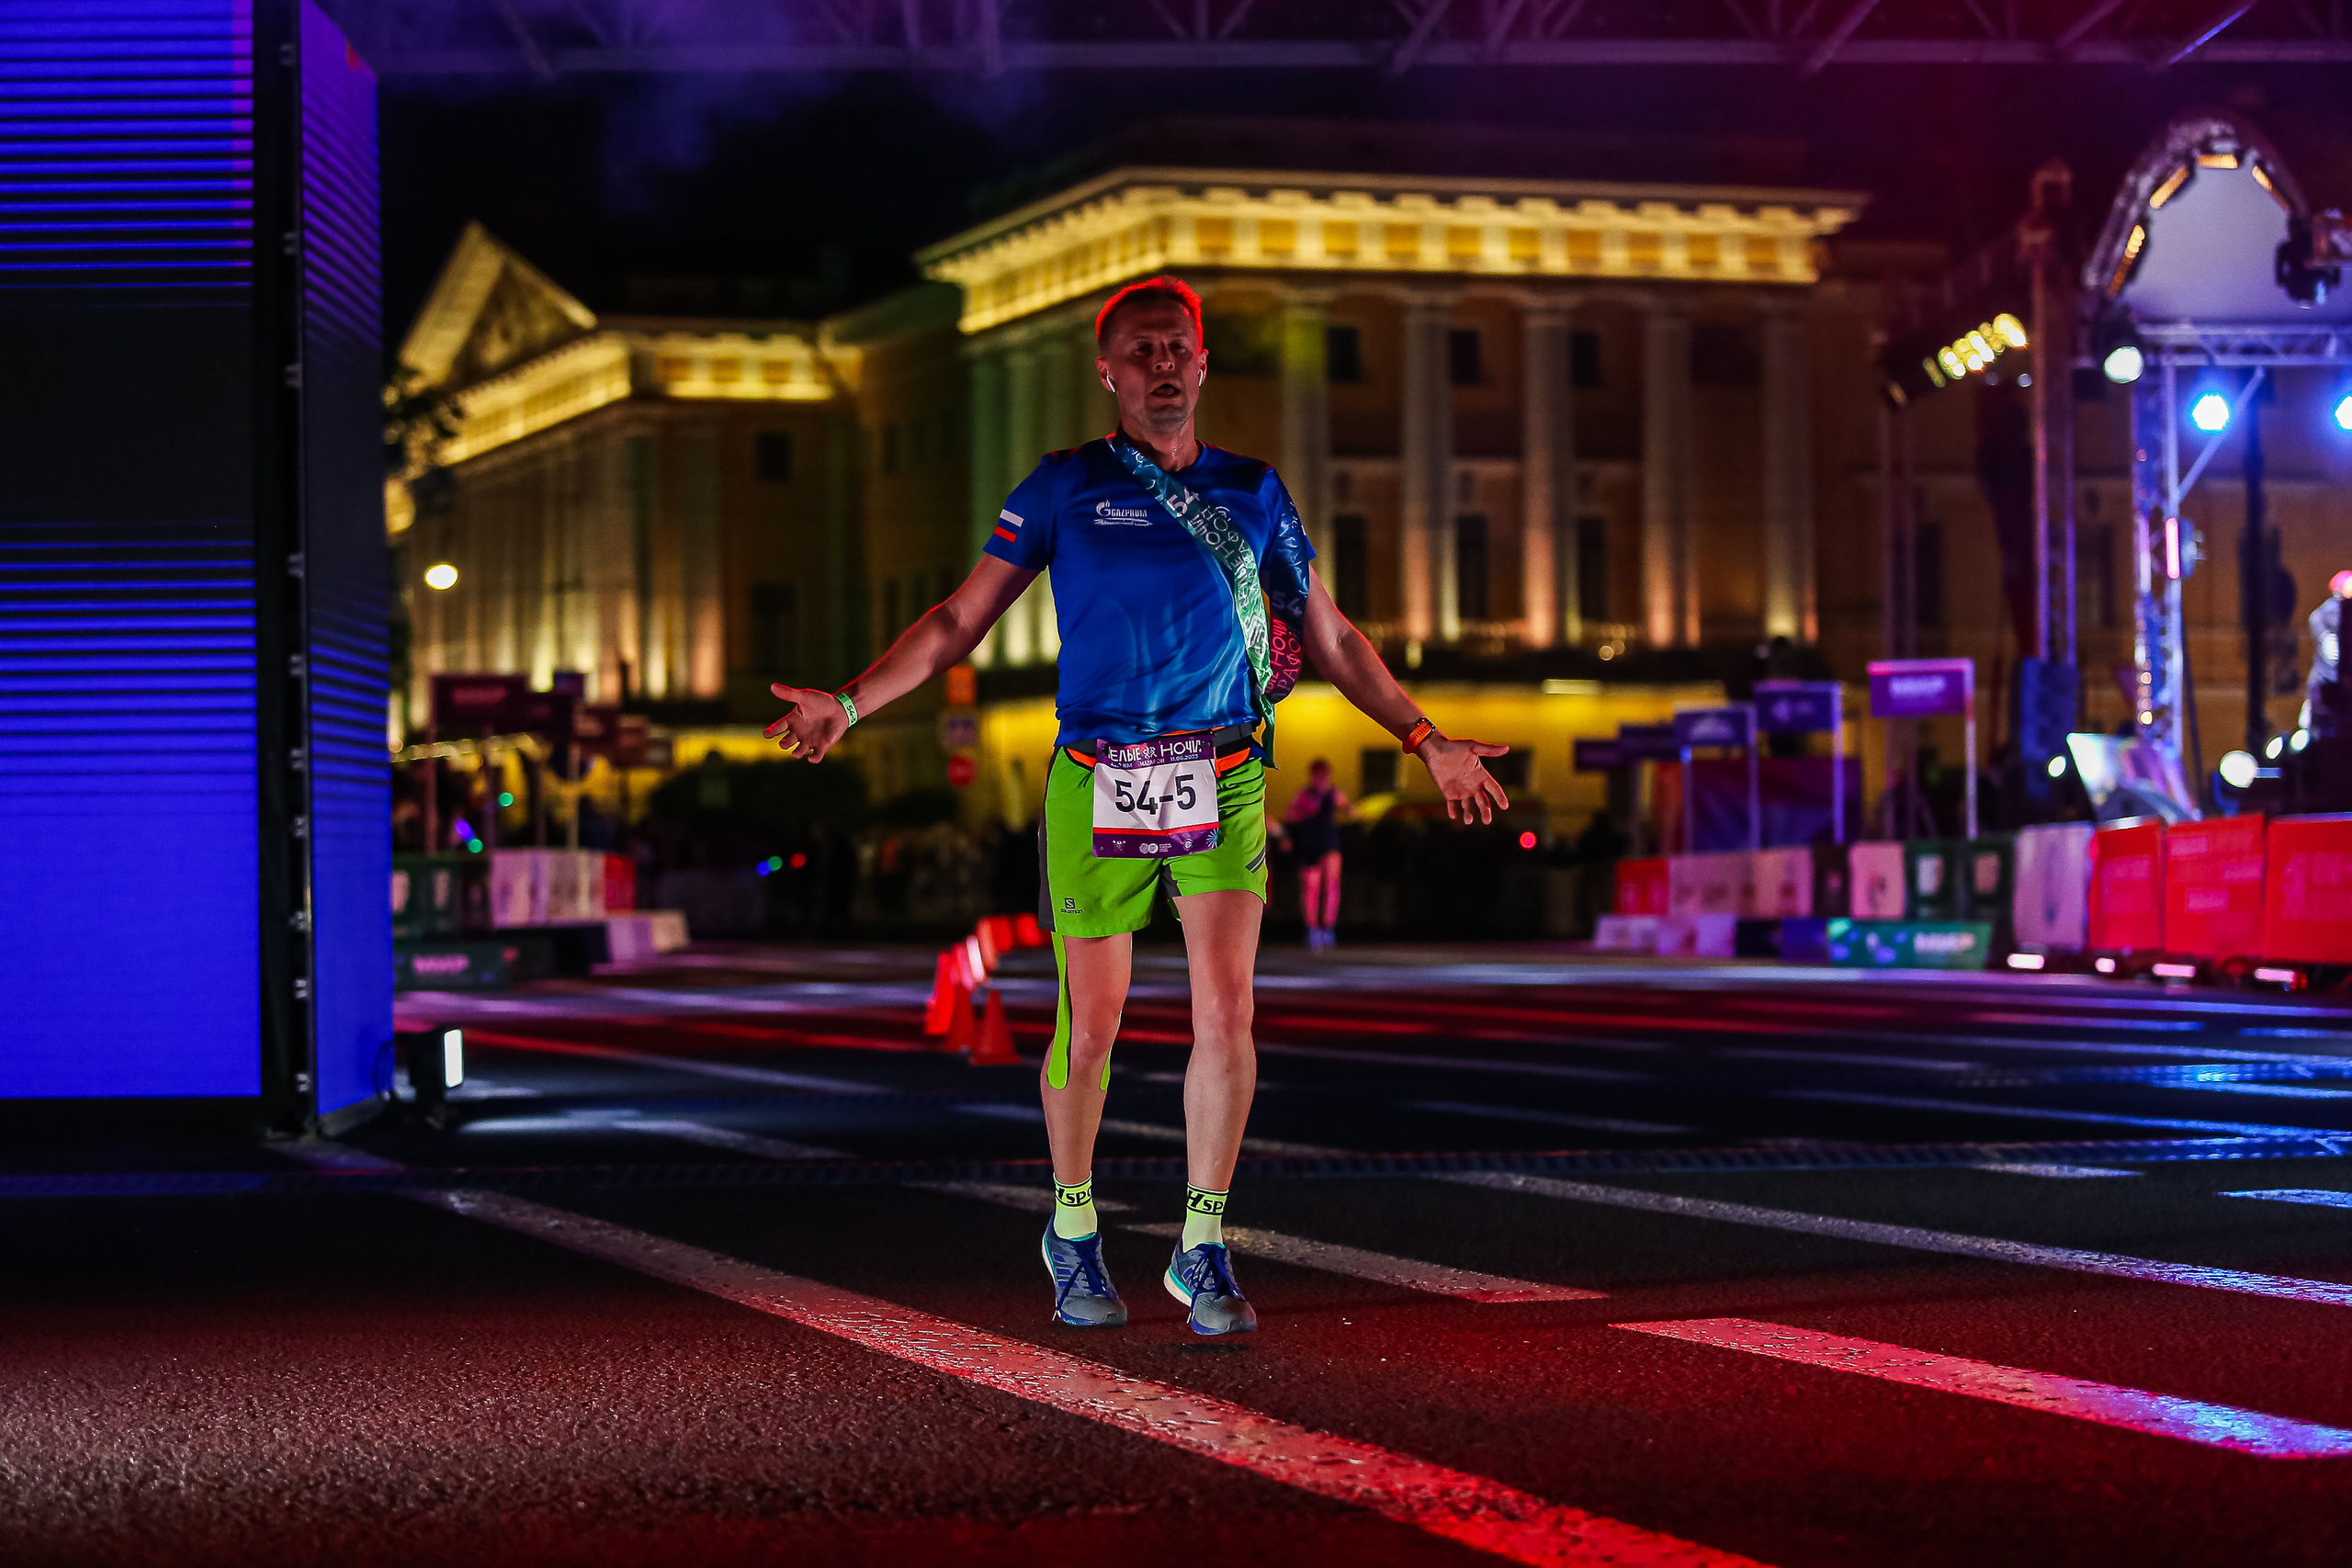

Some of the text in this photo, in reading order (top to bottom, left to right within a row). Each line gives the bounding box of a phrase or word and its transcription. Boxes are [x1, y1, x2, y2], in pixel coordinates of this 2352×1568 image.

[1166, 486, 1200, 518] 54
[1272, 589, 1303, 617] 54
[1271, 618, 1287, 667] НОЧИ
[1114, 773, 1196, 816] 54-5
